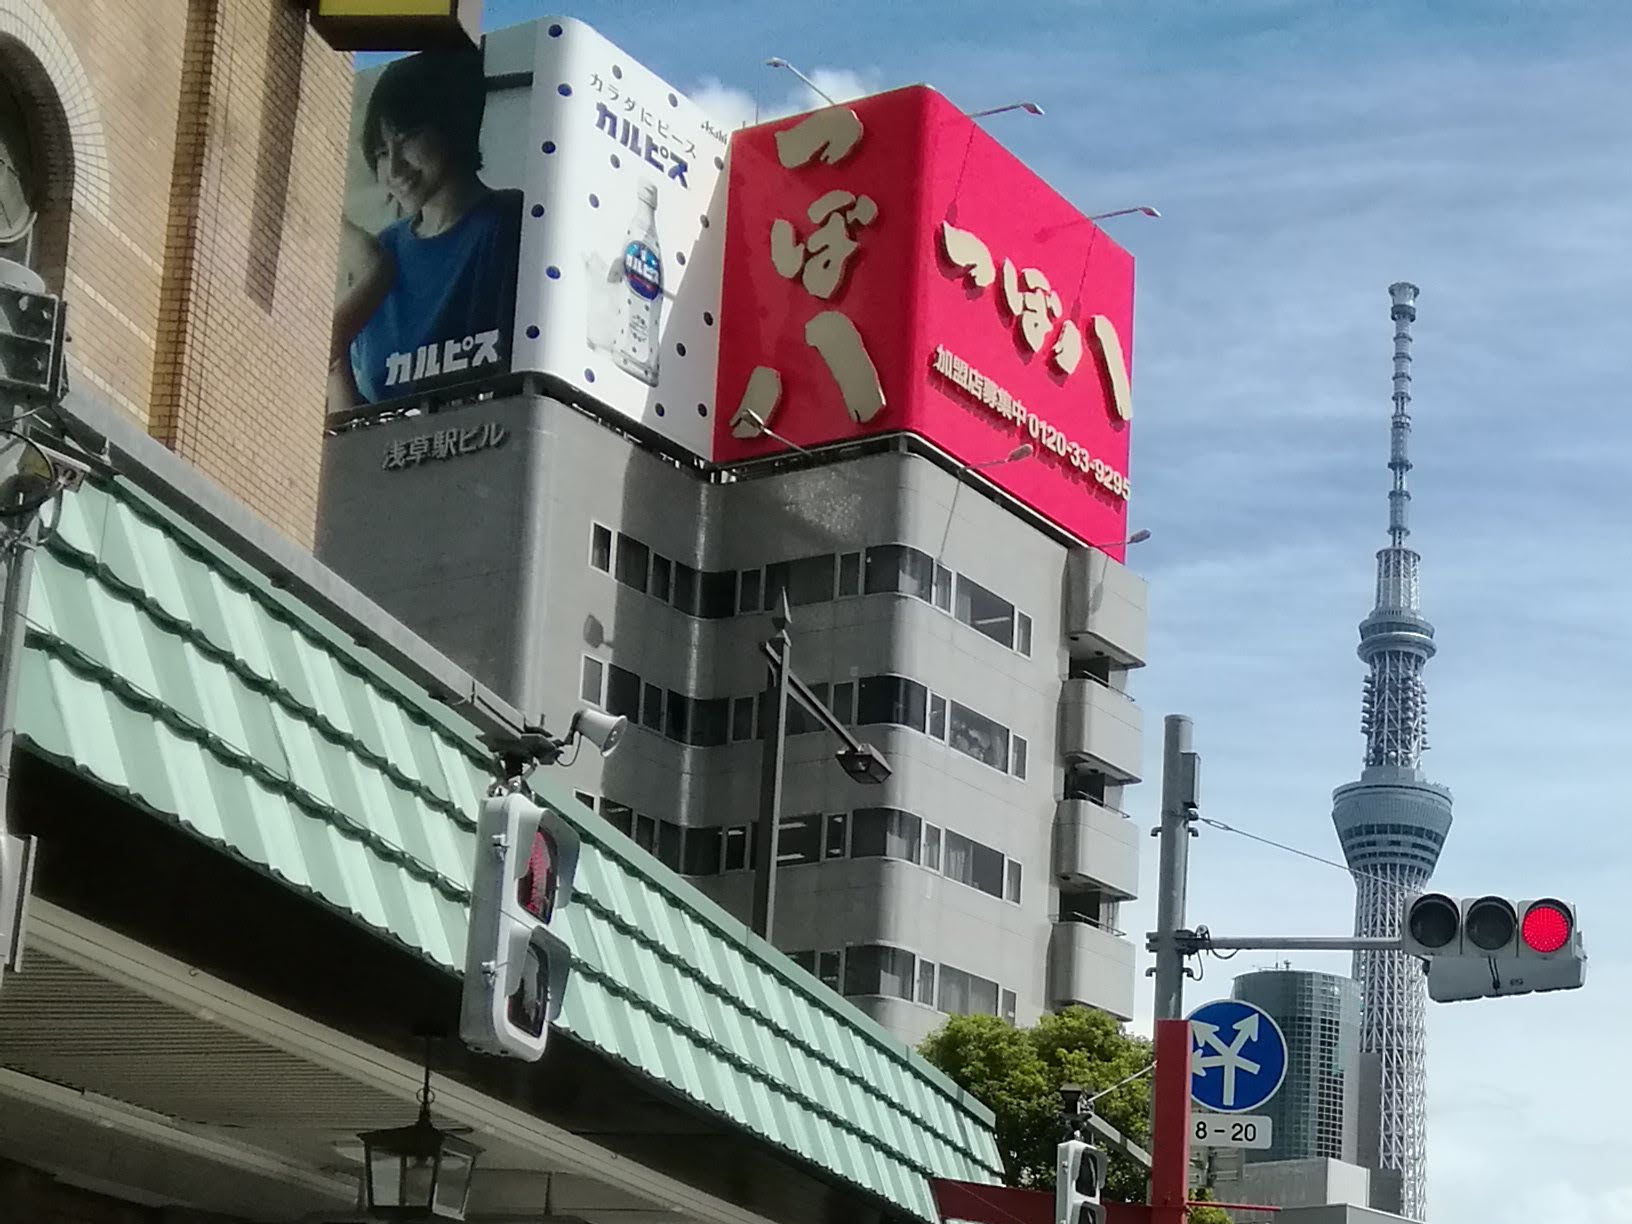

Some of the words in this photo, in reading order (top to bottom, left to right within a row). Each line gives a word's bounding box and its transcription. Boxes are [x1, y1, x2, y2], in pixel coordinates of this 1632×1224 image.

[589, 72, 697, 160] カラダにピース
[596, 101, 689, 190] カルピス
[730, 107, 887, 438] つぼ八
[384, 328, 500, 387] カルピス
[942, 219, 1133, 421] つぼ八
[381, 421, 506, 471] 浅草駅ビル
[932, 344, 1027, 427] 加盟店募集中
[1027, 412, 1131, 500] 0120-33-9295
